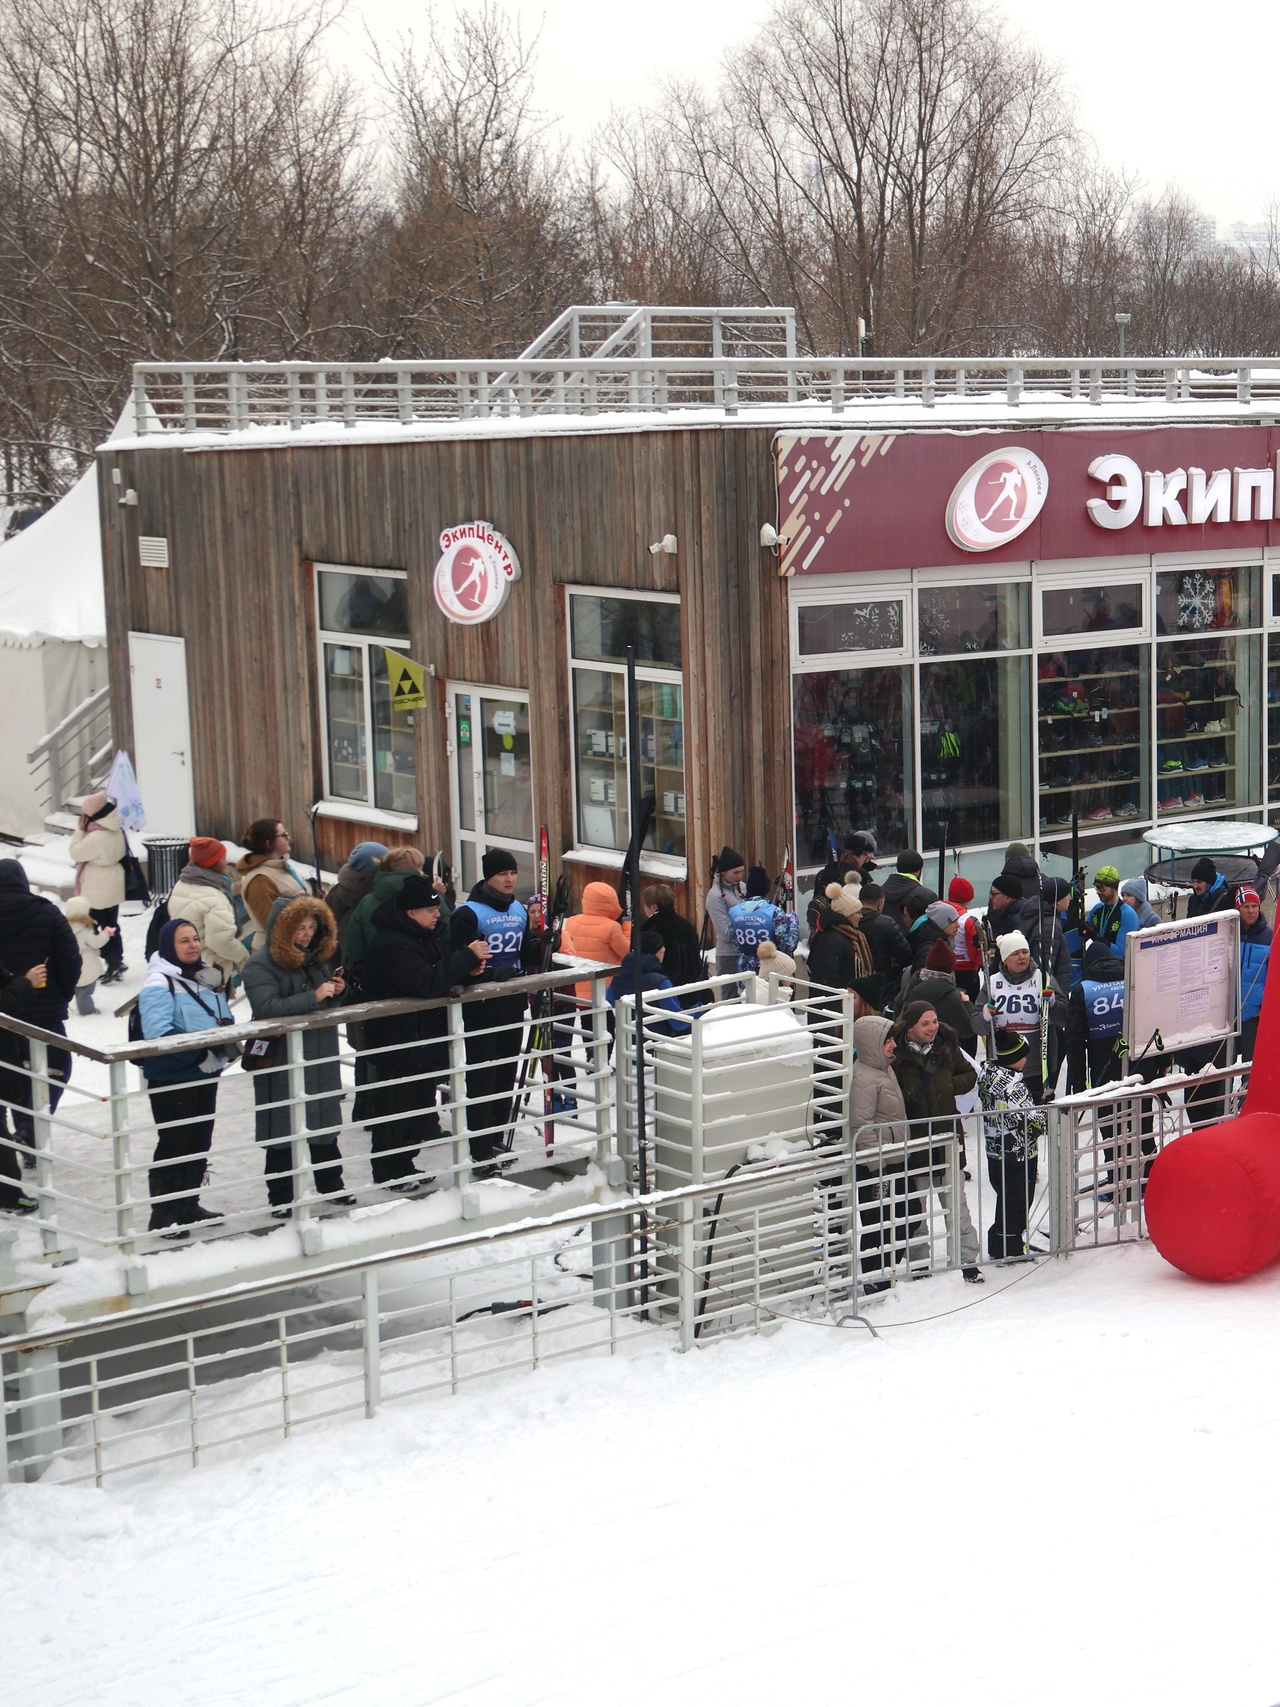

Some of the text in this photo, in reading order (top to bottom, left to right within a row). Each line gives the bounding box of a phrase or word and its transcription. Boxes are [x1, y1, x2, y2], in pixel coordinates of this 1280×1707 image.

[442, 524, 513, 577] ЭкипЦентр
[487, 931, 523, 954] 821
[735, 928, 770, 946] 883
[994, 994, 1038, 1016] 263
